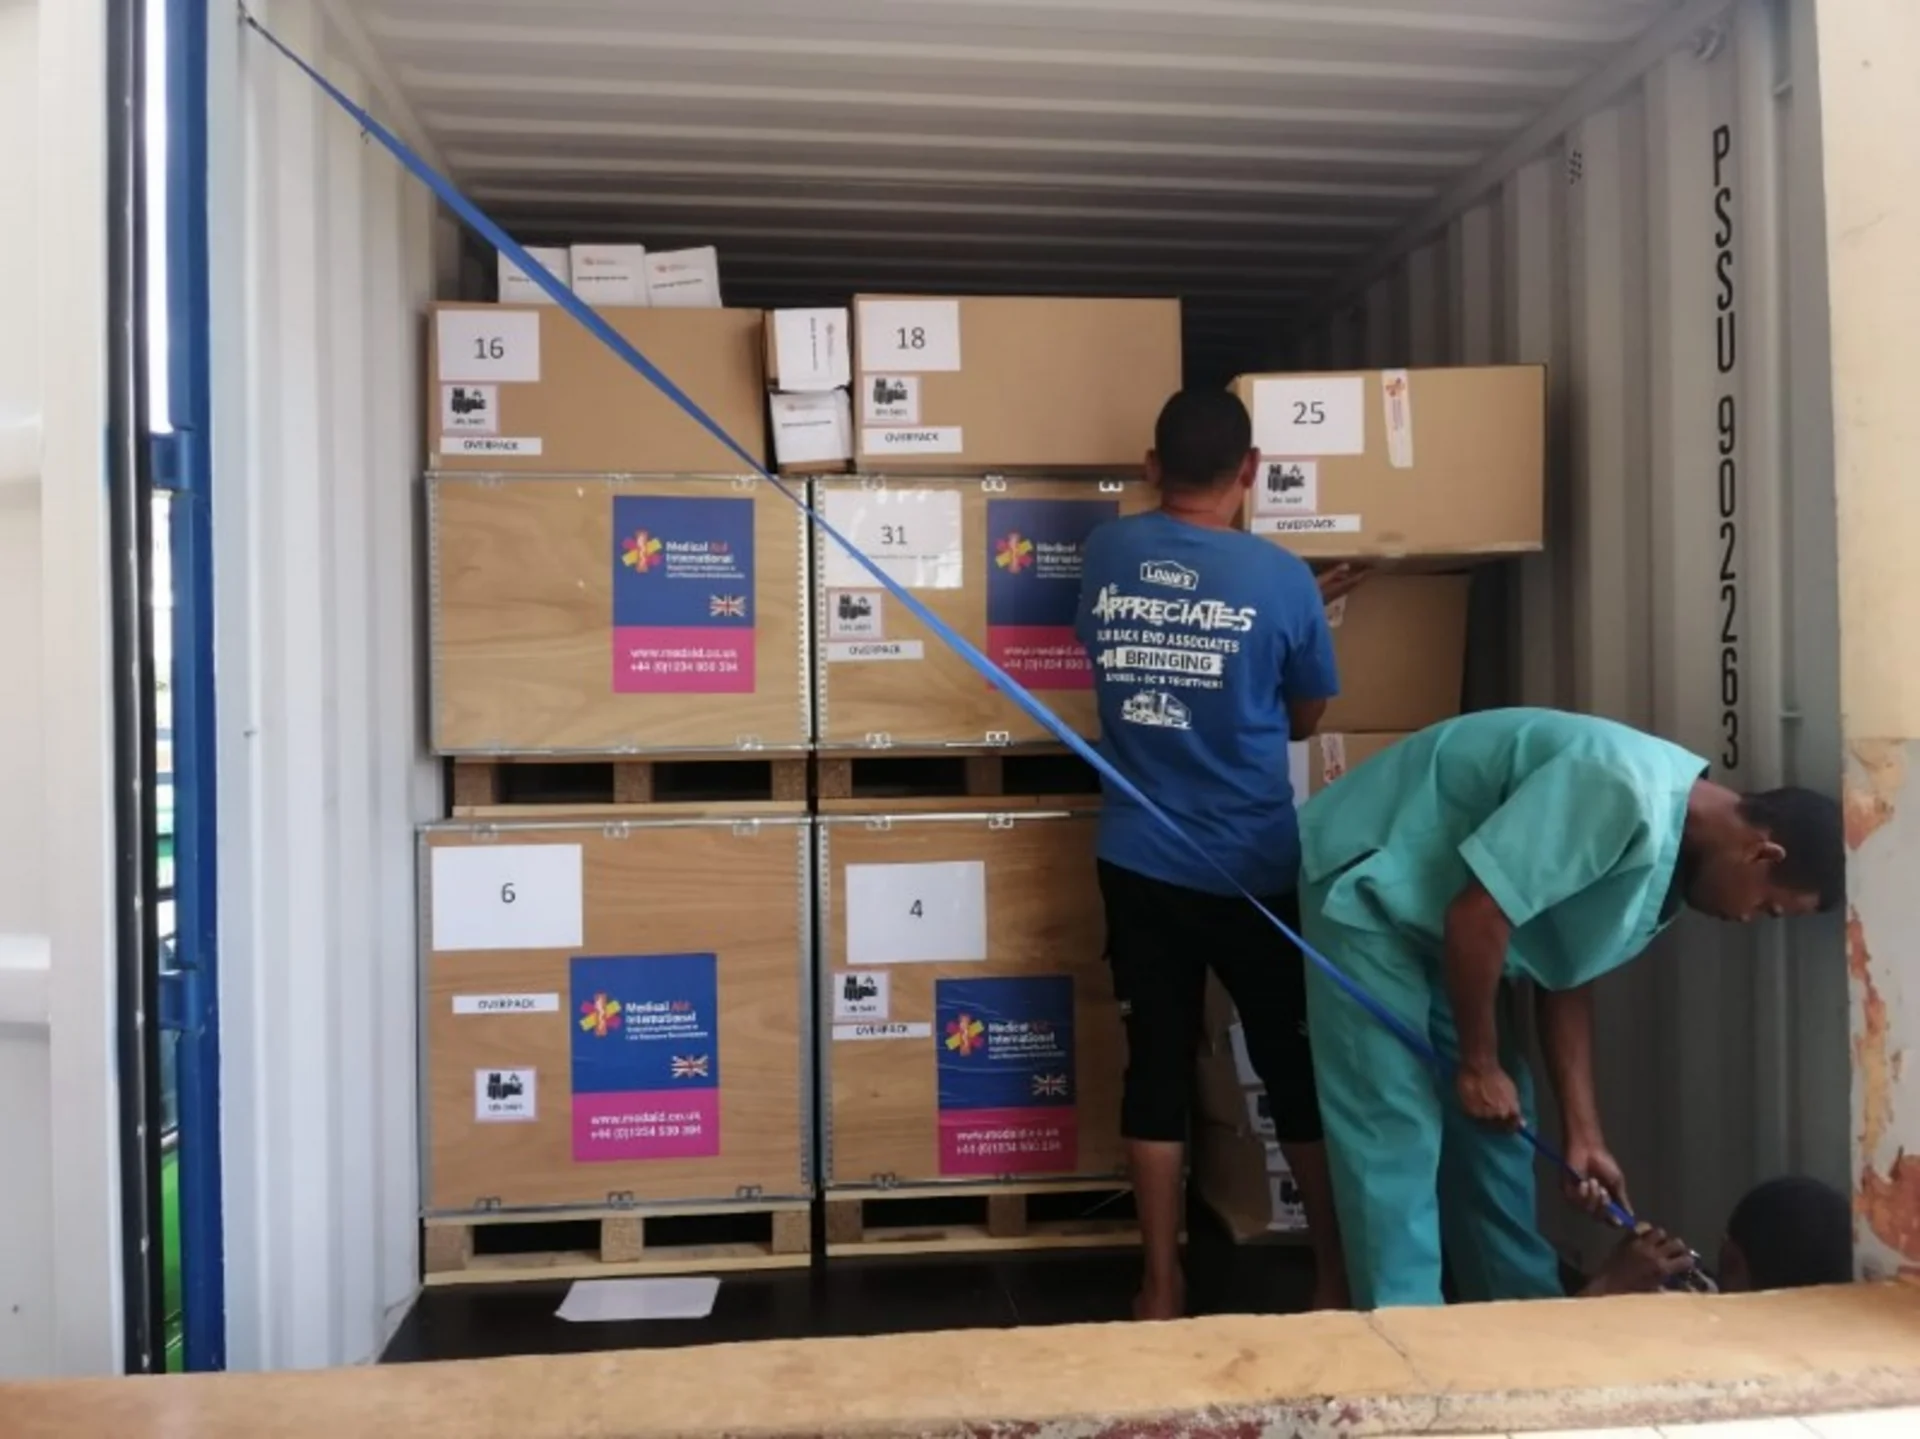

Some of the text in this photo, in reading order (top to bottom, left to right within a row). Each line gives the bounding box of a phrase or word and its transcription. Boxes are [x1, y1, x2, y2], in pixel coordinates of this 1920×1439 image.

[896, 327, 925, 349] 18
[473, 338, 505, 360] 16
[1292, 401, 1326, 425] 25
[884, 432, 939, 443] OVERPACK
[463, 439, 519, 451] OVERPACK
[1711, 124, 1740, 771] PSSU 902263
[1276, 519, 1336, 530] OVERPACK
[880, 525, 908, 546] 31
[665, 541, 709, 552] Medical
[1036, 542, 1076, 552] Medical
[665, 553, 734, 564] International
[1092, 585, 1257, 632] APPRECIATES
[1113, 630, 1140, 643] BACK
[1141, 631, 1166, 645] END
[1166, 634, 1240, 653] ASSOCIATES
[1003, 645, 1088, 656] www.medaid.co
[1125, 650, 1213, 671] BRINGING
[500, 882, 516, 904] 6
[909, 899, 924, 919] 4
[625, 1001, 670, 1013] Medical
[625, 1012, 697, 1025] International
[988, 1021, 1029, 1033] Medical
[988, 1032, 1056, 1044] International
